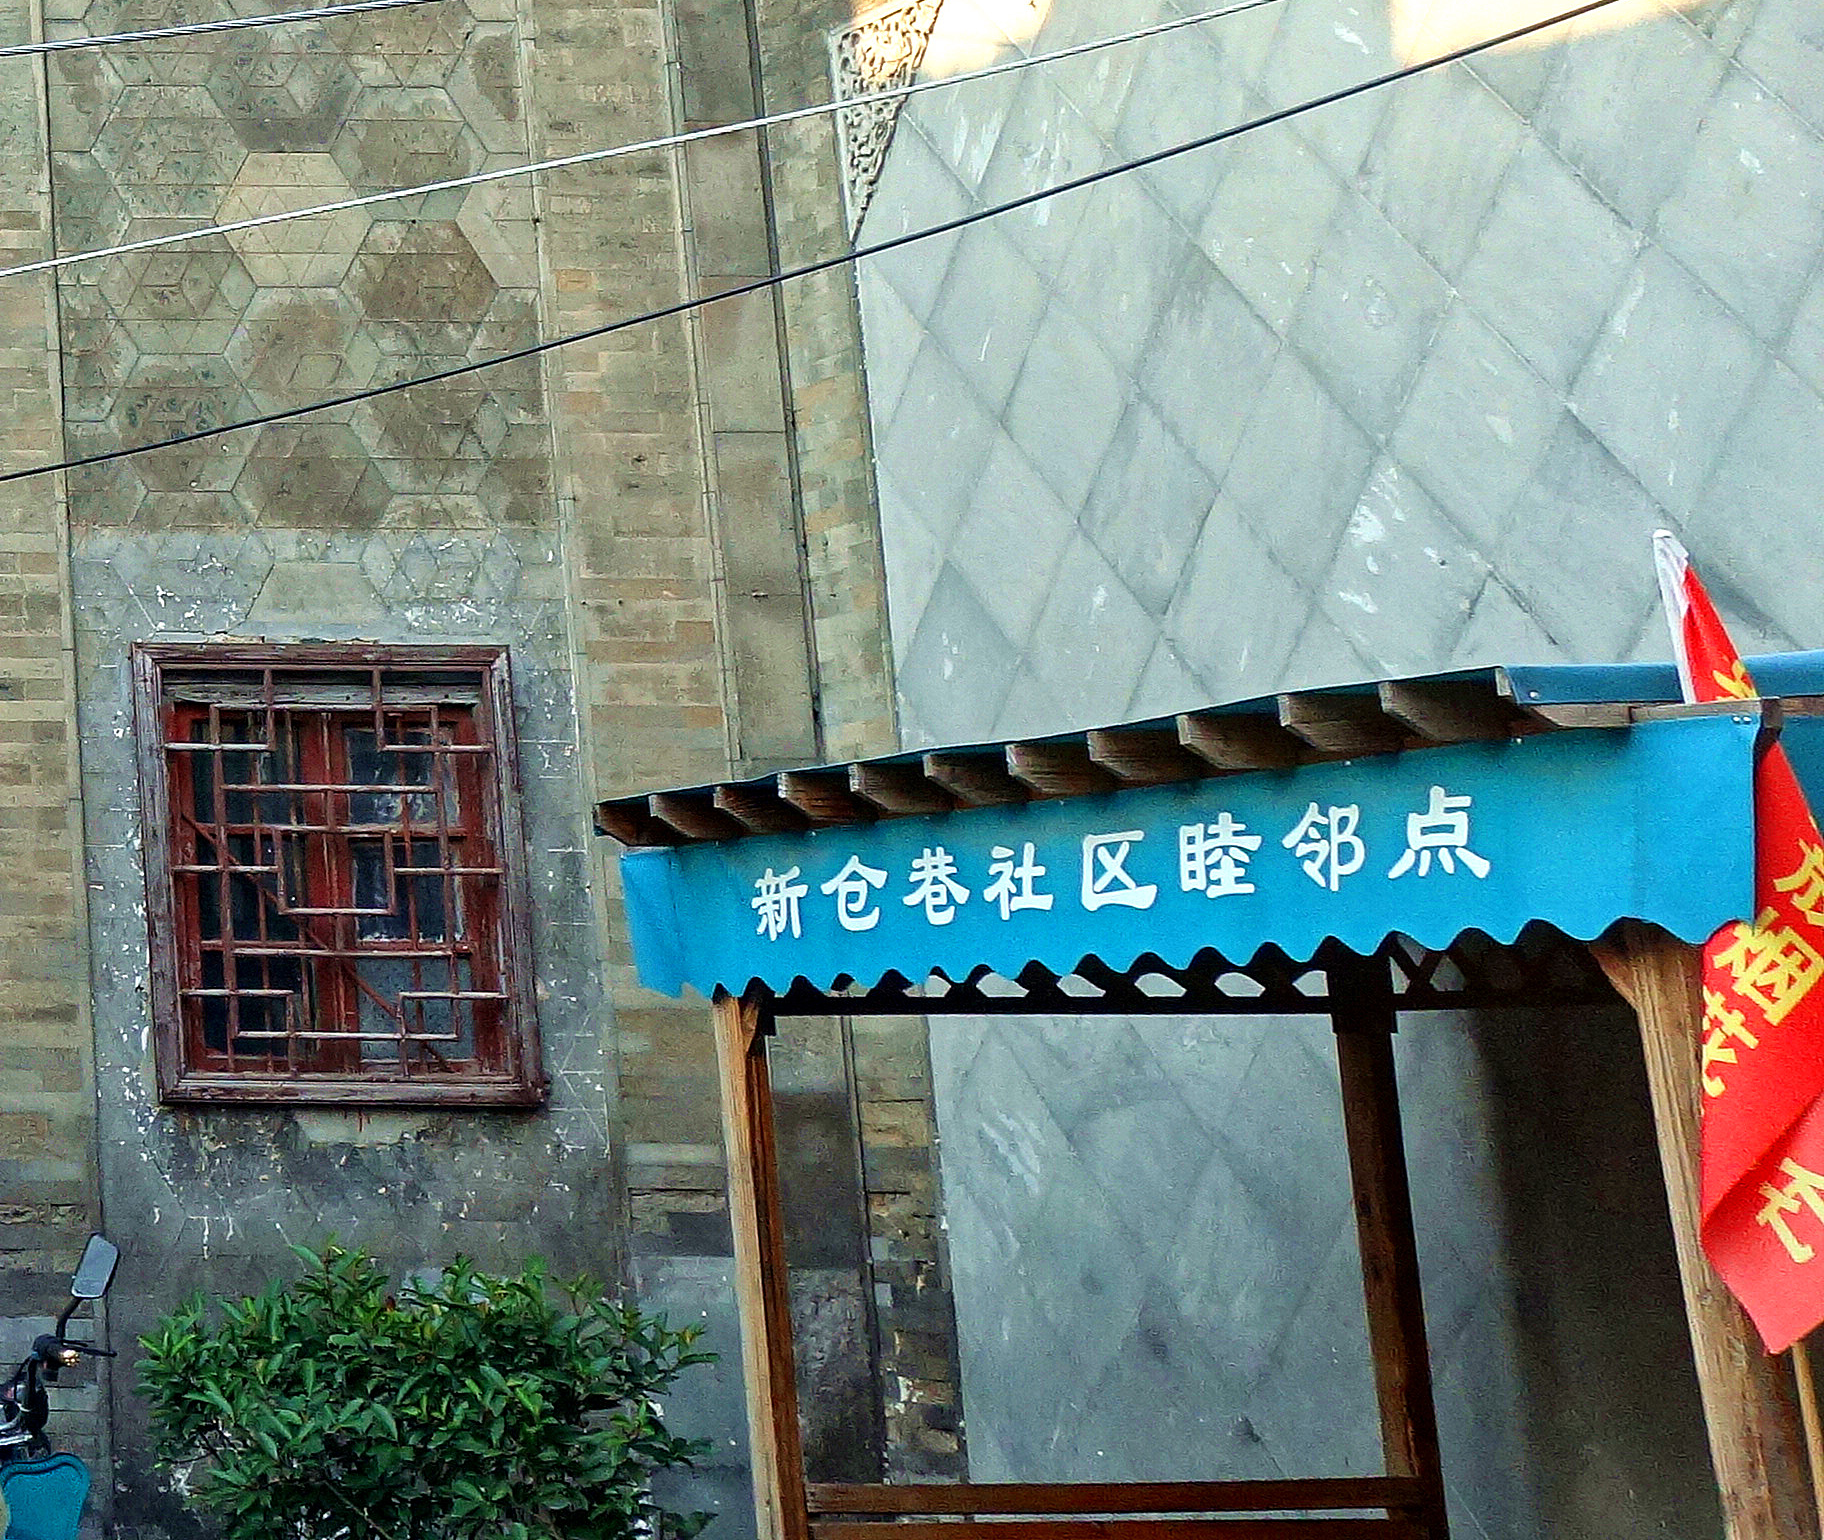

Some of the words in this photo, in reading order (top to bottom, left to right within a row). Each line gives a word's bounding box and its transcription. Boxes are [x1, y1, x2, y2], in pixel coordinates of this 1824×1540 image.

[752, 785, 1490, 942] 新仓巷社区睦邻点
